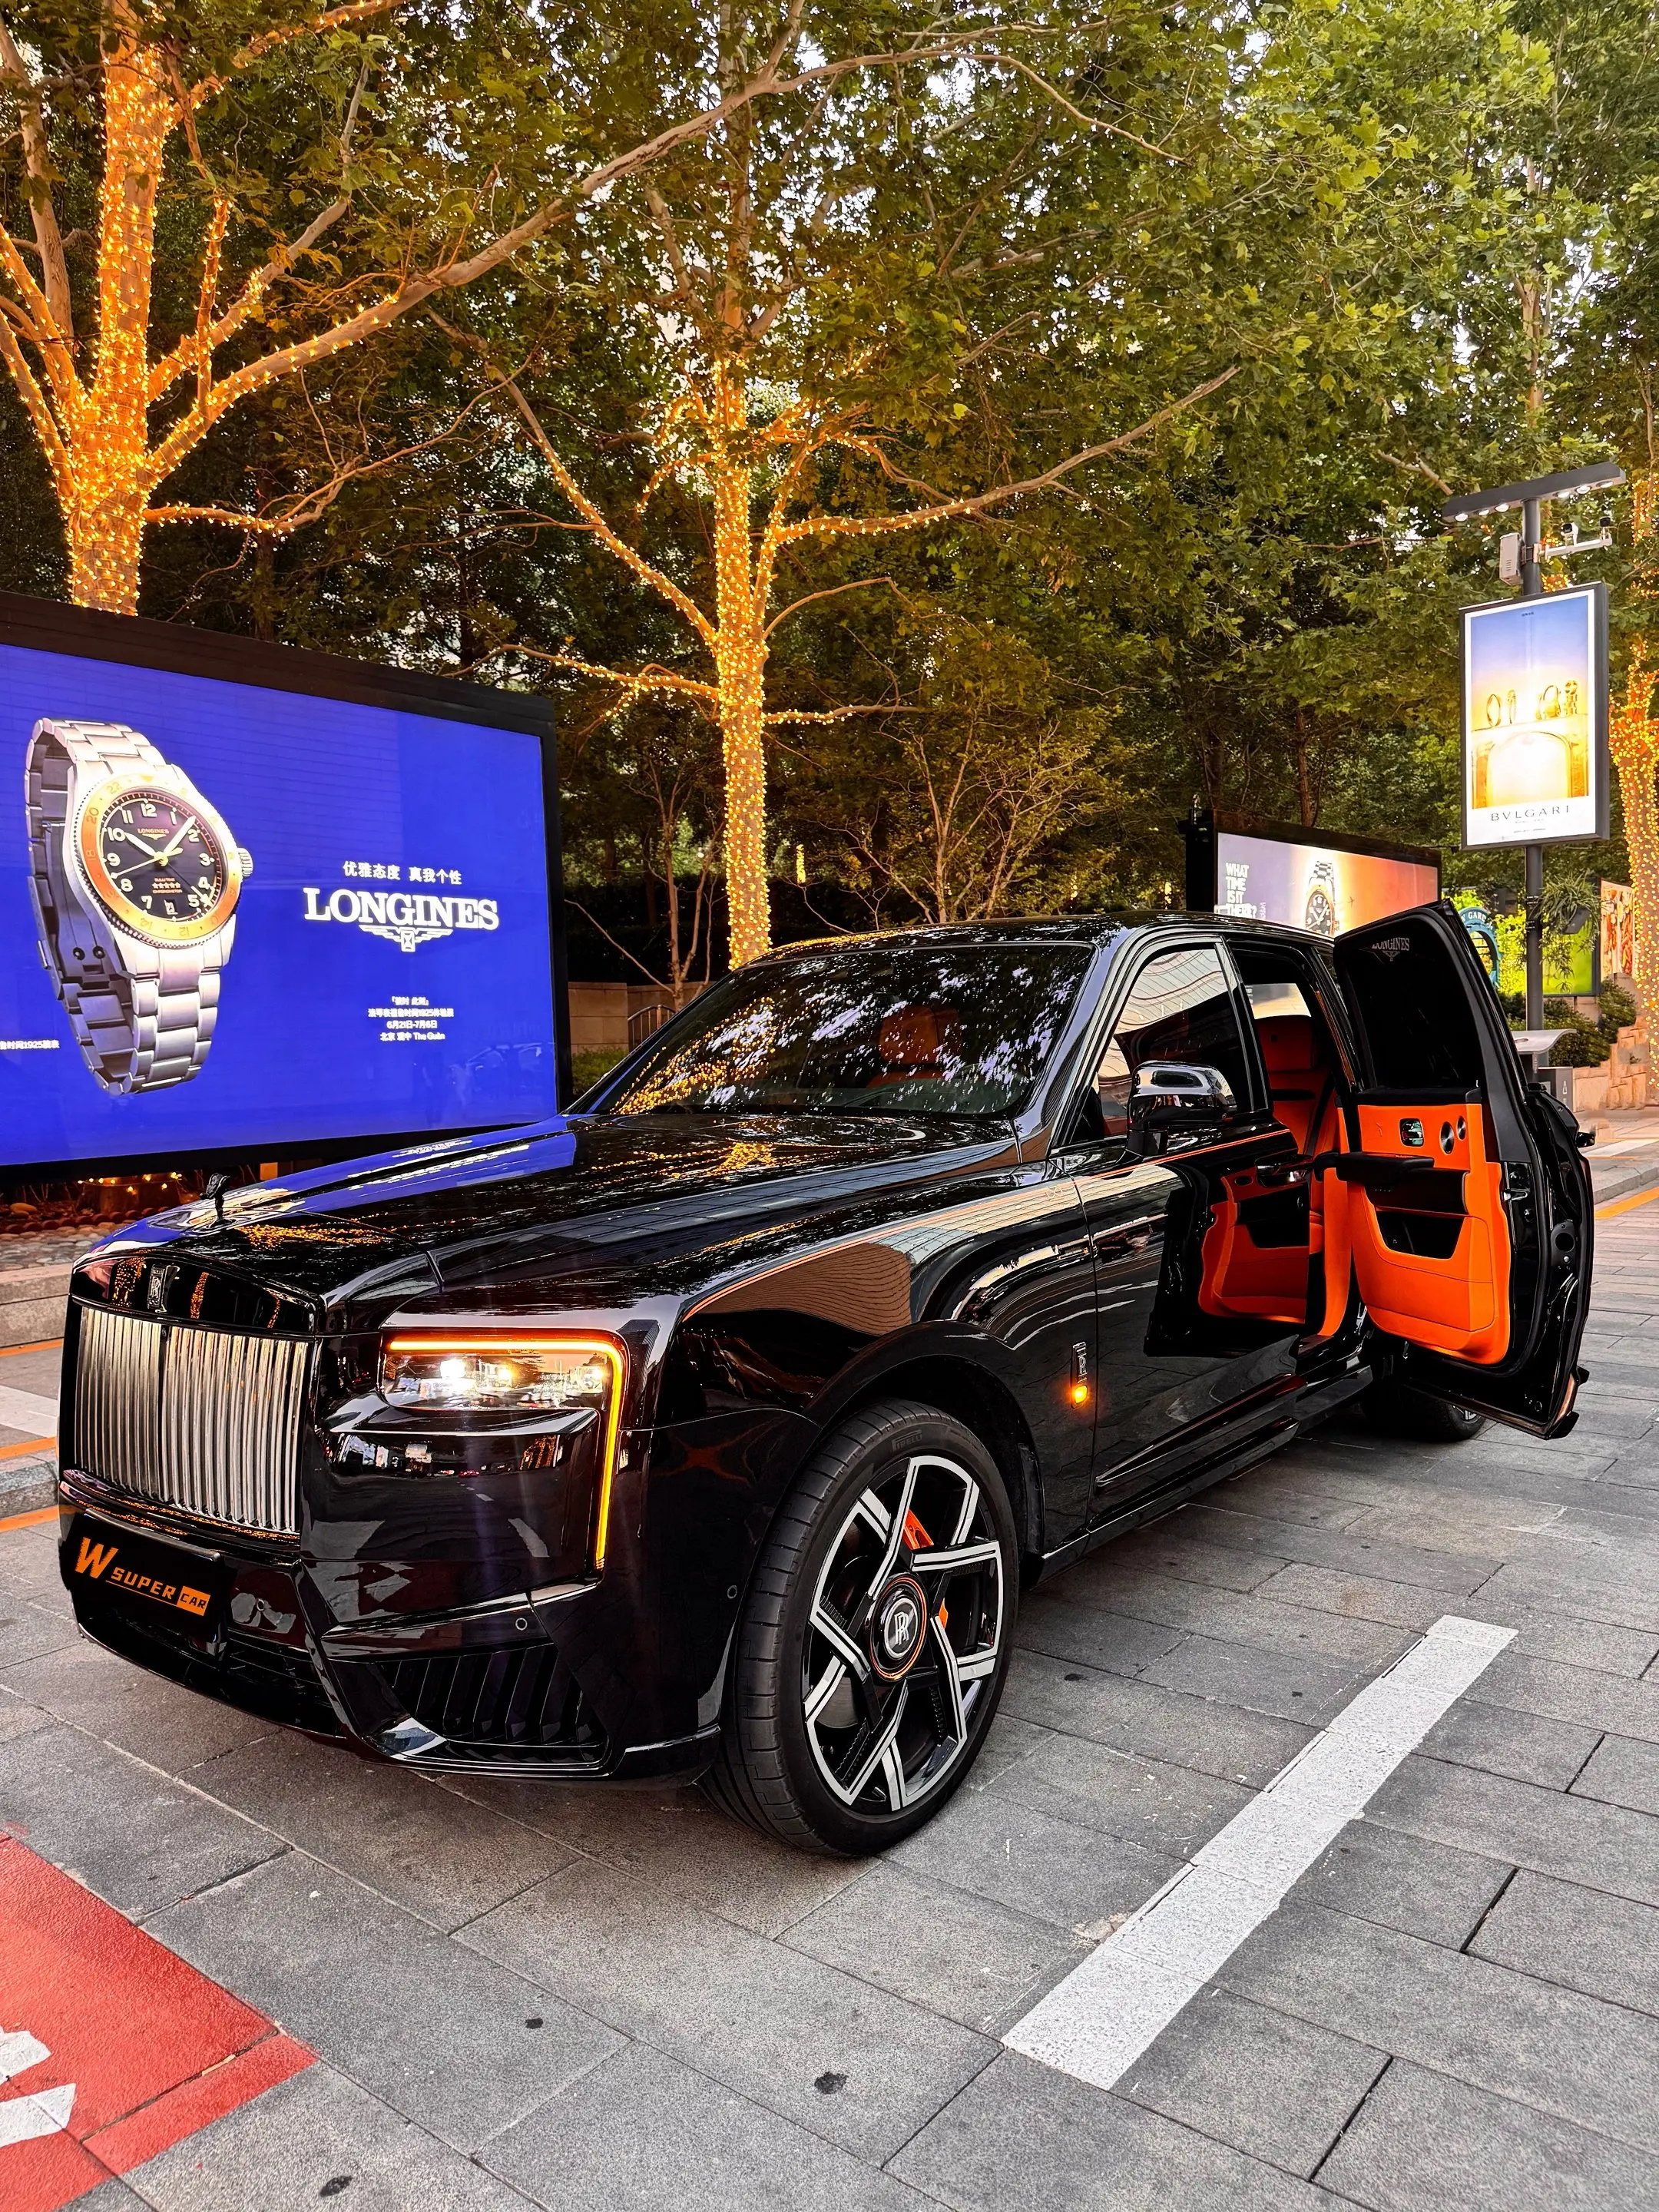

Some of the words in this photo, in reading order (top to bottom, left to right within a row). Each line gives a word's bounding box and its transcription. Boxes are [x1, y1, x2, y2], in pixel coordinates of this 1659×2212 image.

[86, 807, 99, 825] 20
[121, 810, 134, 824] 11
[141, 803, 157, 817] 12
[1491, 805, 1569, 822] BVLGARI
[107, 827, 126, 842] 10
[188, 829, 199, 843] 2
[107, 853, 121, 866] 9
[199, 853, 210, 866] 3
[343, 861, 400, 880] 优雅态度
[409, 866, 462, 885] 真我个性
[1225, 863, 1250, 878] WHAT
[121, 879, 134, 892] 8
[198, 876, 210, 889] 4
[1225, 876, 1247, 891] TIME
[141, 896, 152, 909] 7
[187, 895, 200, 908] 5
[1227, 890, 1236, 903] IS
[1236, 891, 1244, 904] IT
[303, 887, 500, 930] LONGINES
[892, 1429, 922, 1452] PIRELLI
[75, 1536, 119, 1579] W
[111, 1566, 177, 1600] SUPER
[180, 1593, 207, 1609] CAR
[893, 1611, 909, 1646] RR
